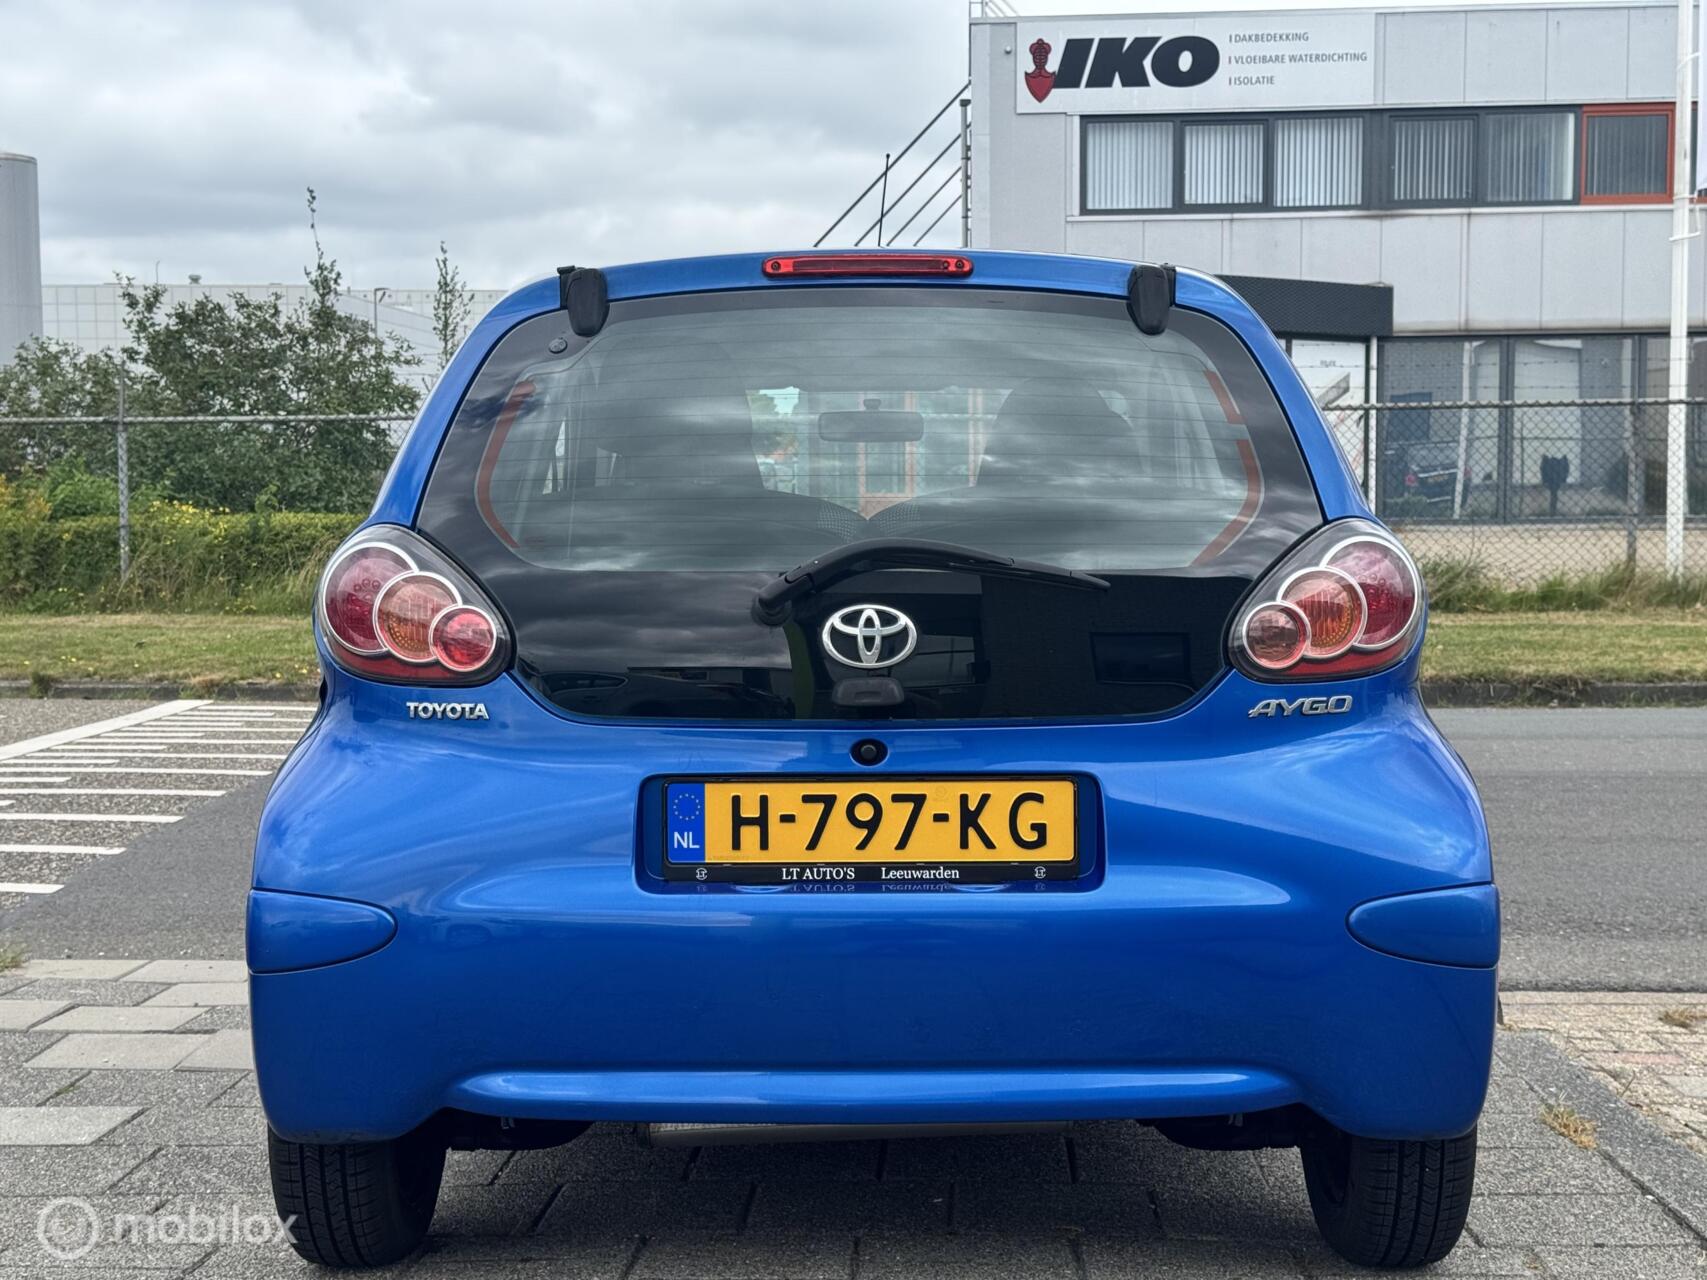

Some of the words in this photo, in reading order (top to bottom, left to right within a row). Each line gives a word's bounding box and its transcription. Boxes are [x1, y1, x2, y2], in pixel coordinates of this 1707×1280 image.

[1234, 32, 1309, 43] DAKBEDEKKING
[1055, 35, 1220, 88] IKO
[1234, 54, 1286, 65] VLOEIBARE
[1288, 52, 1368, 63] WATERDICHTING
[1234, 76, 1275, 86] ISOLATIE
[406, 702, 489, 719] TOYOTA
[1248, 695, 1353, 718] AYGO
[730, 792, 1048, 851] H-797-KG
[673, 831, 700, 849] NL
[782, 868, 800, 880] LT
[803, 868, 855, 880] AUTO'S
[881, 867, 960, 879] Leeuwarden
